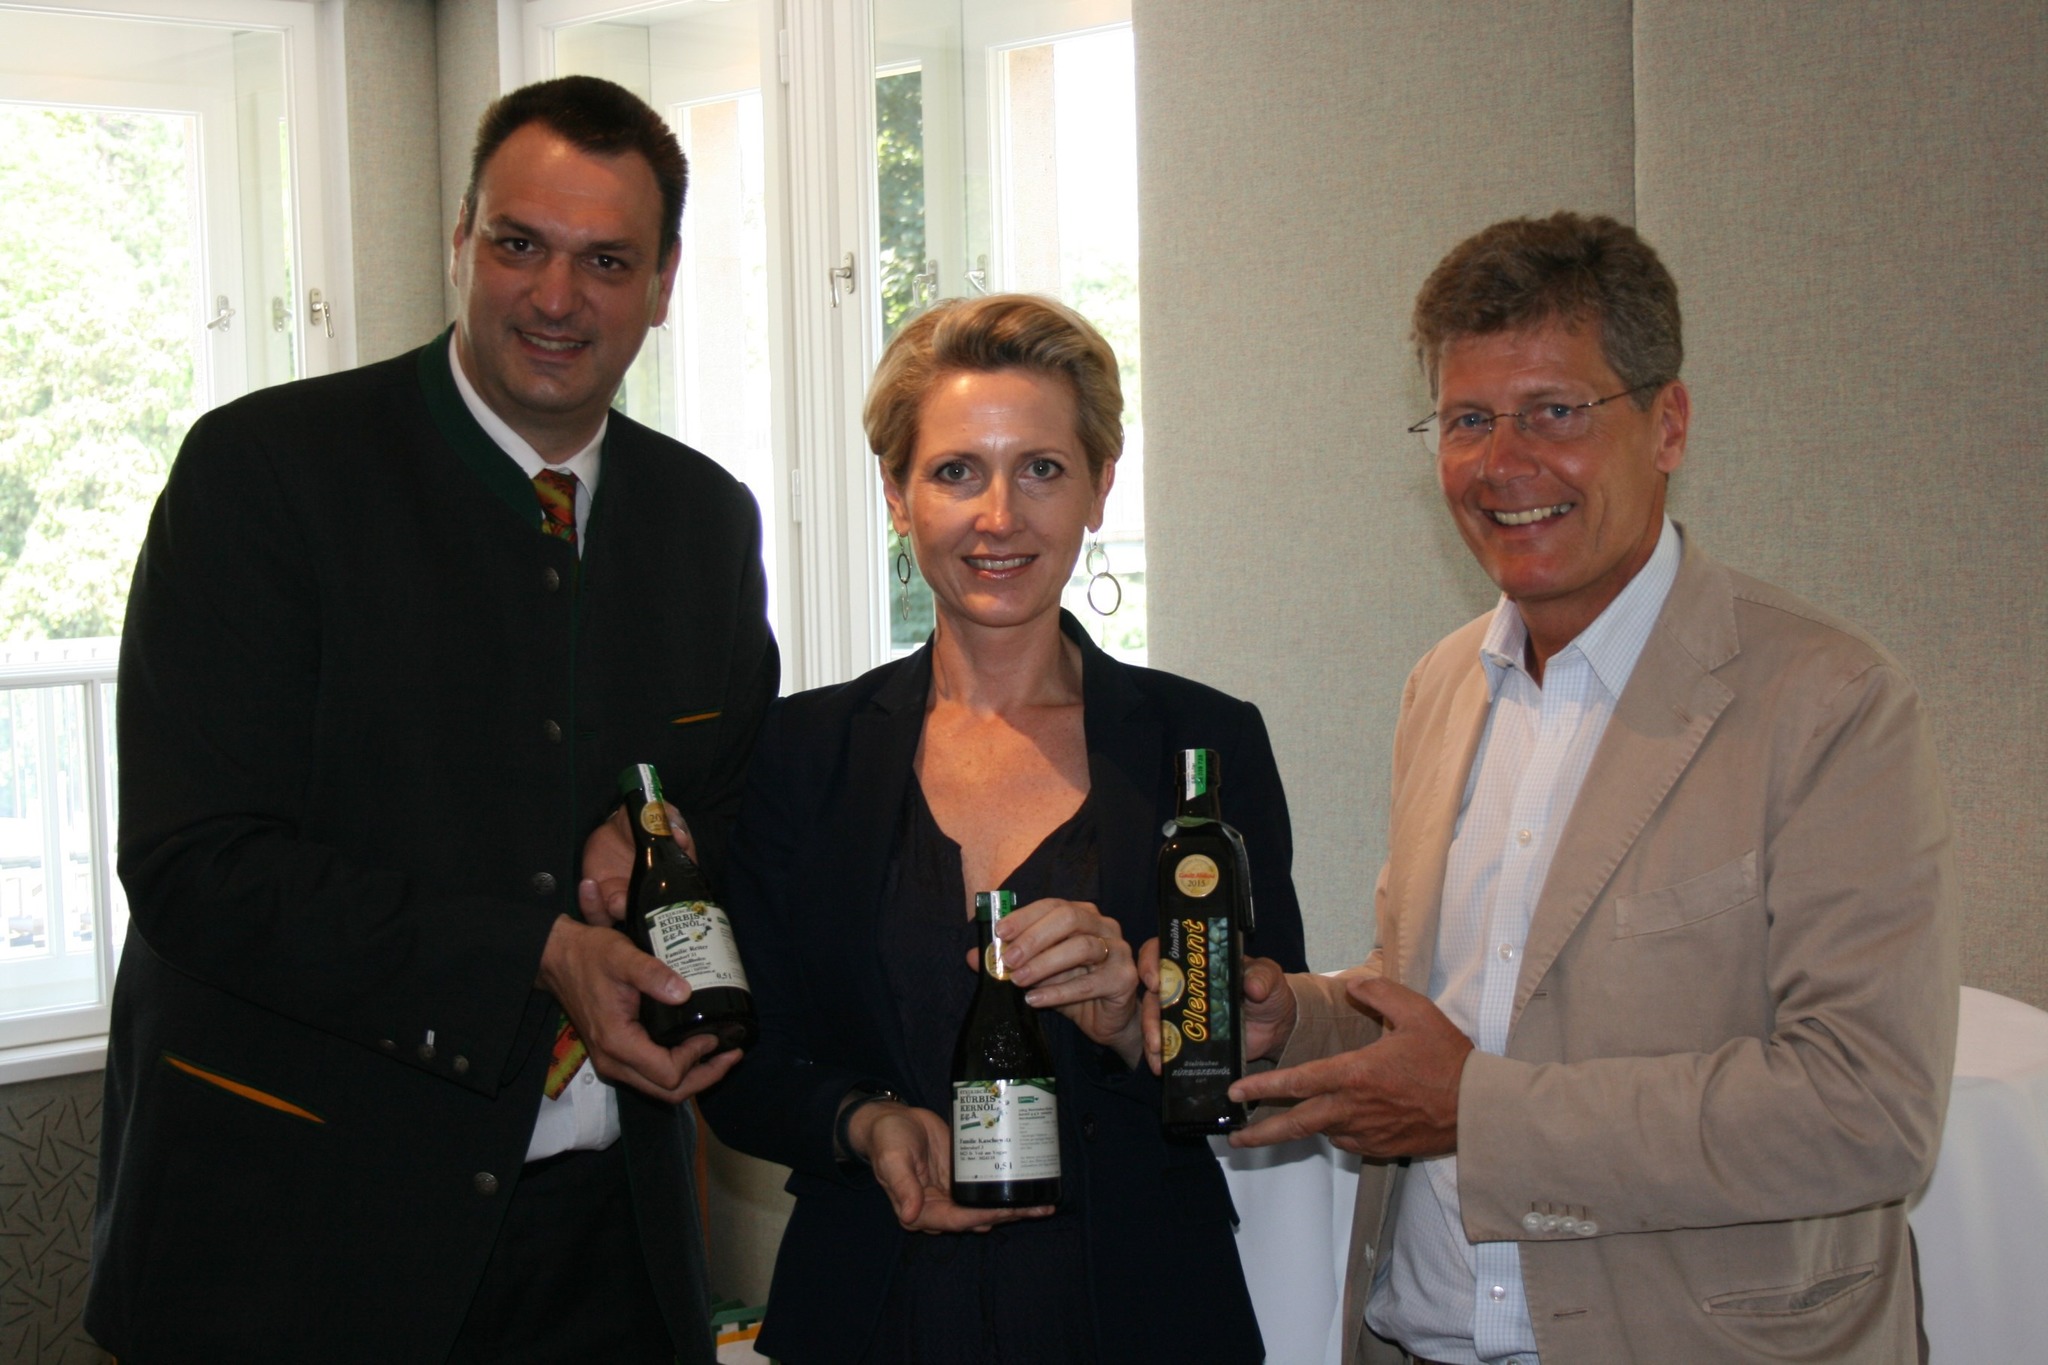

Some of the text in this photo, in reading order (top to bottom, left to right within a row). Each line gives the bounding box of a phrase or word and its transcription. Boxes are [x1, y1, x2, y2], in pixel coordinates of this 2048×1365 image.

[660, 913, 700, 928] KÜRBIS
[1181, 918, 1208, 1042] Clement
[960, 1095, 996, 1104] KÜRBIS
